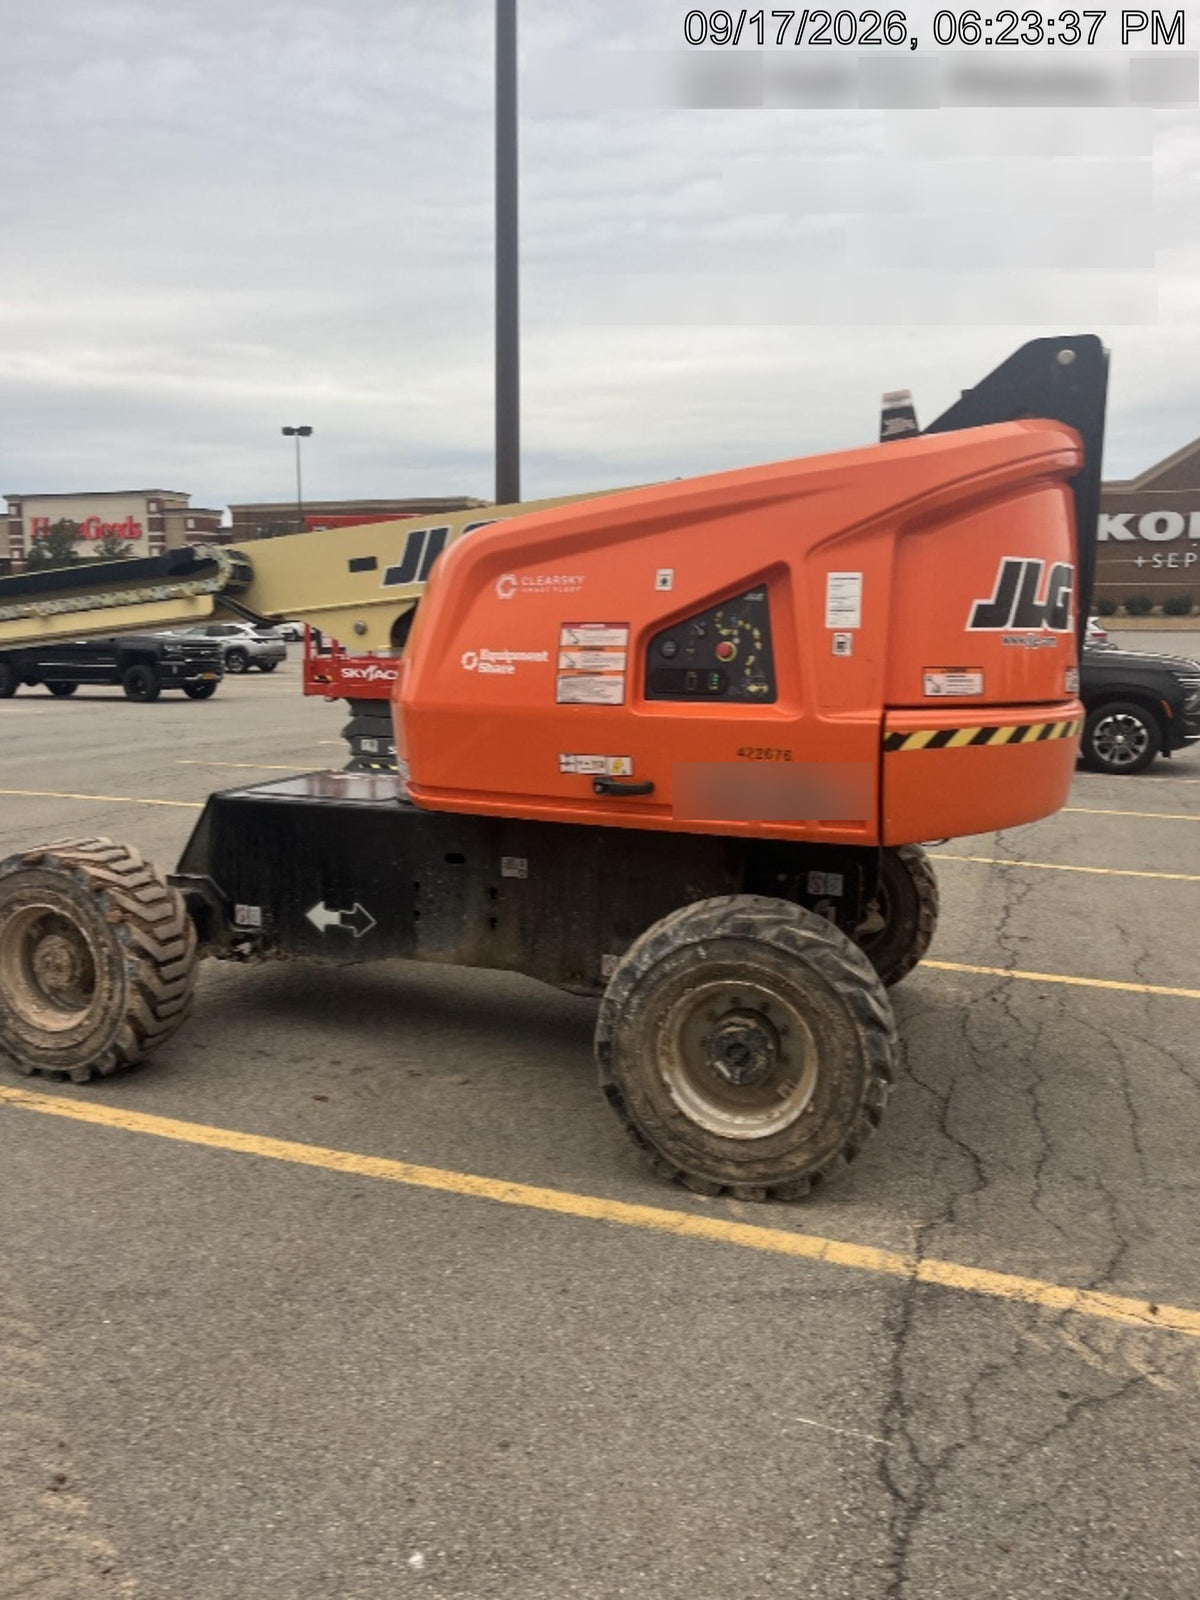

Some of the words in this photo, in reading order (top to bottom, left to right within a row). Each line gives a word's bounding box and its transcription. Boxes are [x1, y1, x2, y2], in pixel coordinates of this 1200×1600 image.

[30, 515, 142, 540] HGoods
[521, 575, 585, 586] CLEARSKY
[965, 556, 1075, 633] JLG
[340, 665, 399, 682] SKYJAC
[736, 746, 793, 762] 422676
